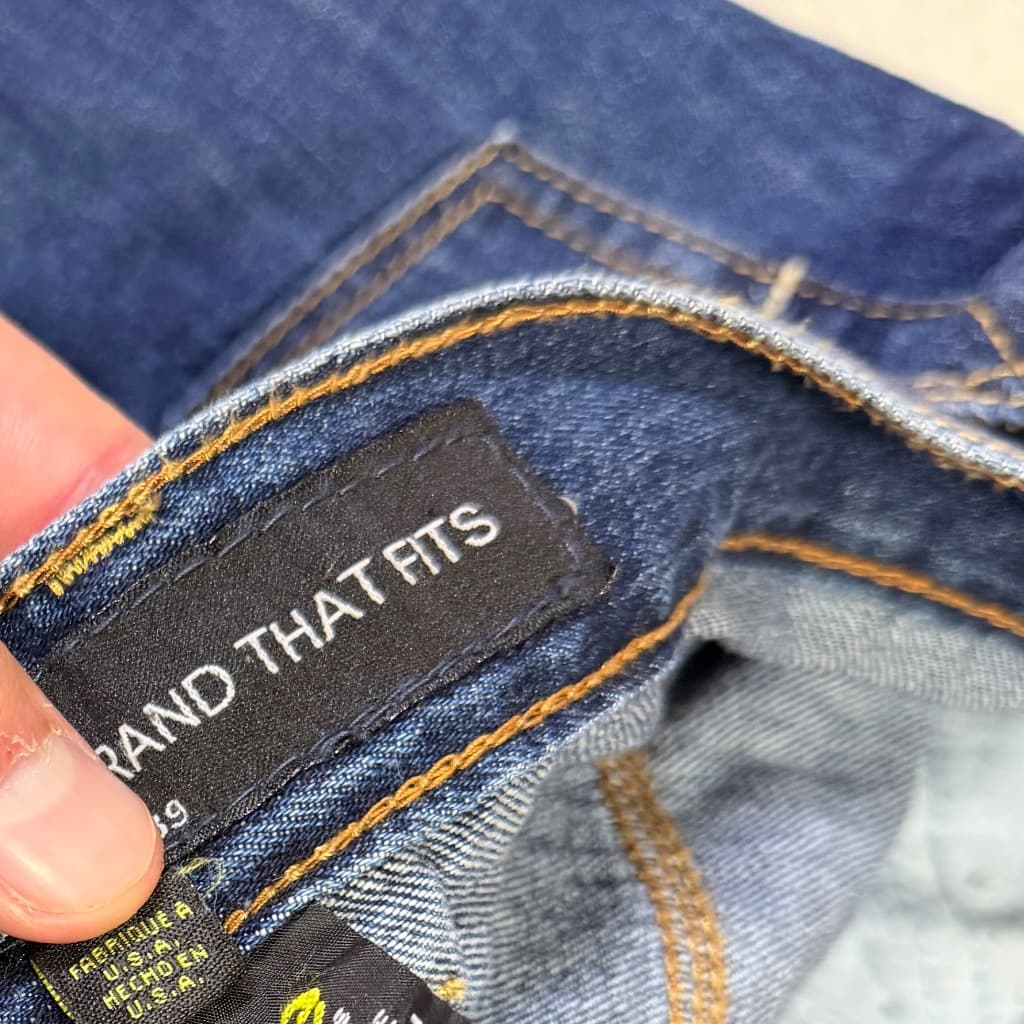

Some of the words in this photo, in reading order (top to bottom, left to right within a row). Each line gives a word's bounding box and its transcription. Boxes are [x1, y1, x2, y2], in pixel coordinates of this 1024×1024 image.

[95, 663, 237, 783] RAND
[232, 556, 386, 675] THAT
[382, 500, 502, 587] FITS
[100, 960, 173, 1011] HECHO
[175, 942, 209, 970] EN
[126, 974, 205, 1020] U.S.A.
